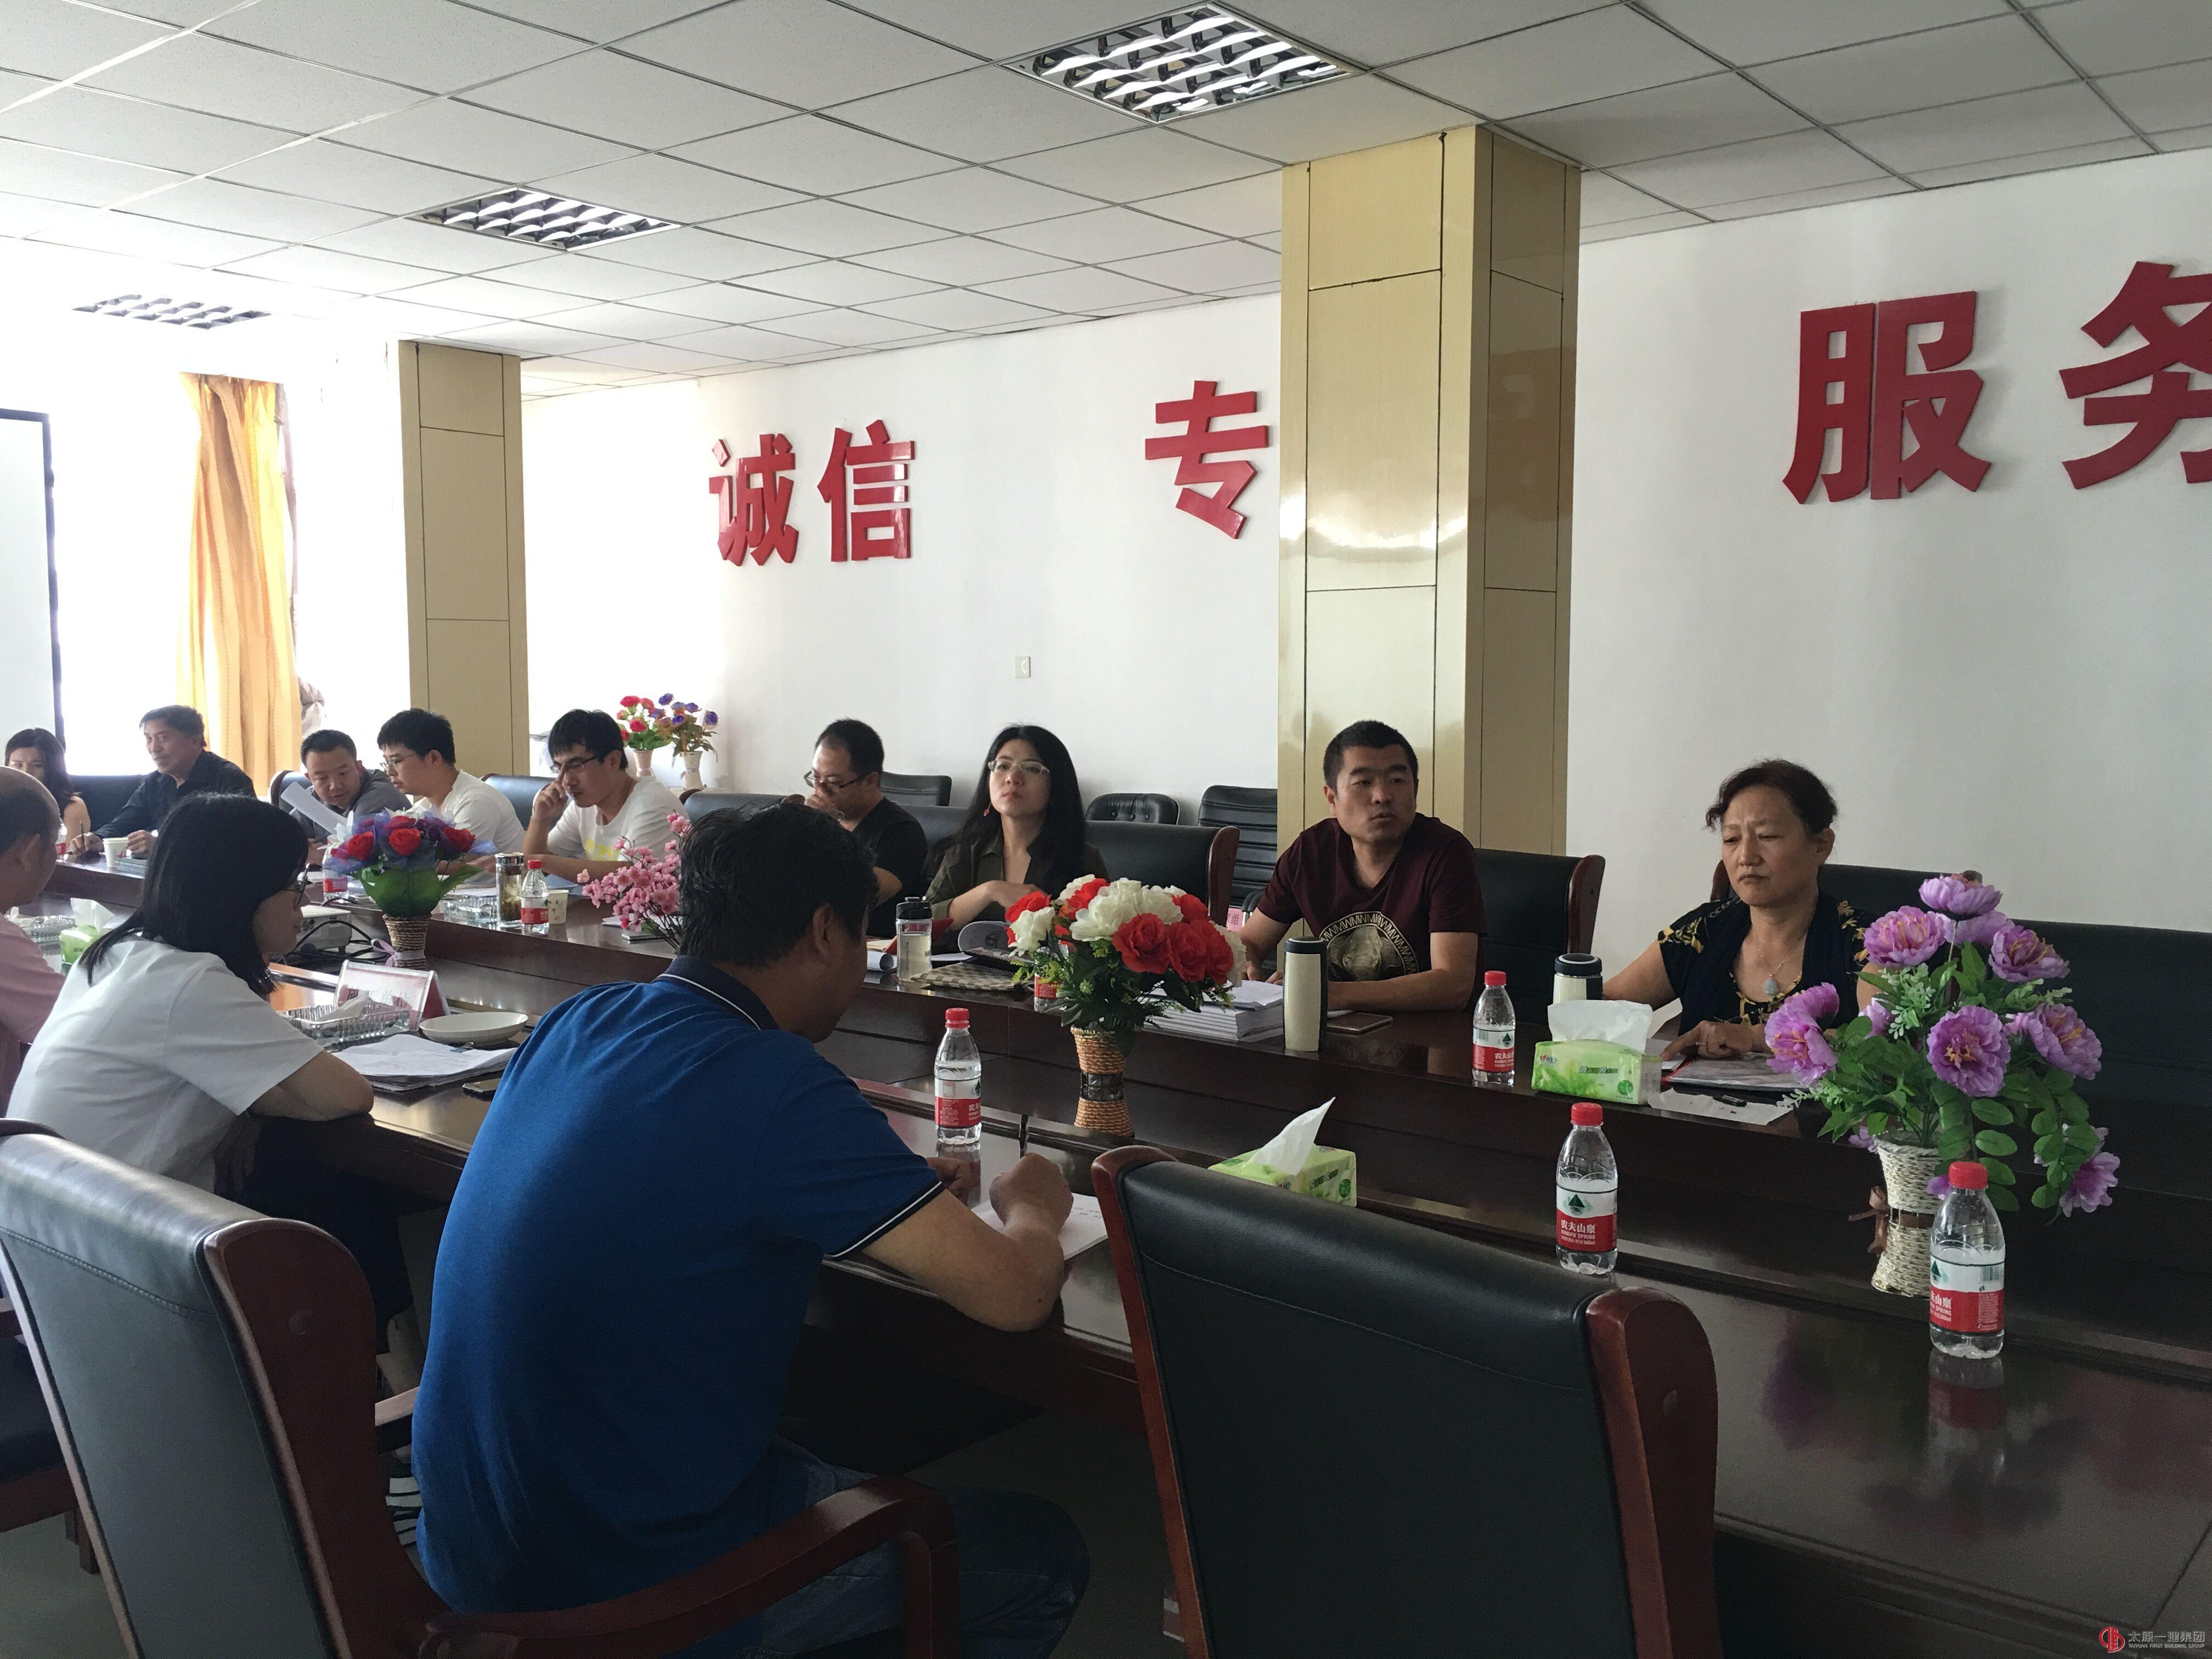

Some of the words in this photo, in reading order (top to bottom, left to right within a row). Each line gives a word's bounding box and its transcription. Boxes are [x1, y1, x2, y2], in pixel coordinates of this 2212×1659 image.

[708, 419, 915, 566] 诚信
[1144, 380, 1269, 539] 专
[1782, 260, 2212, 505] 服务
[1561, 1219, 1596, 1234] 农夫山泉
